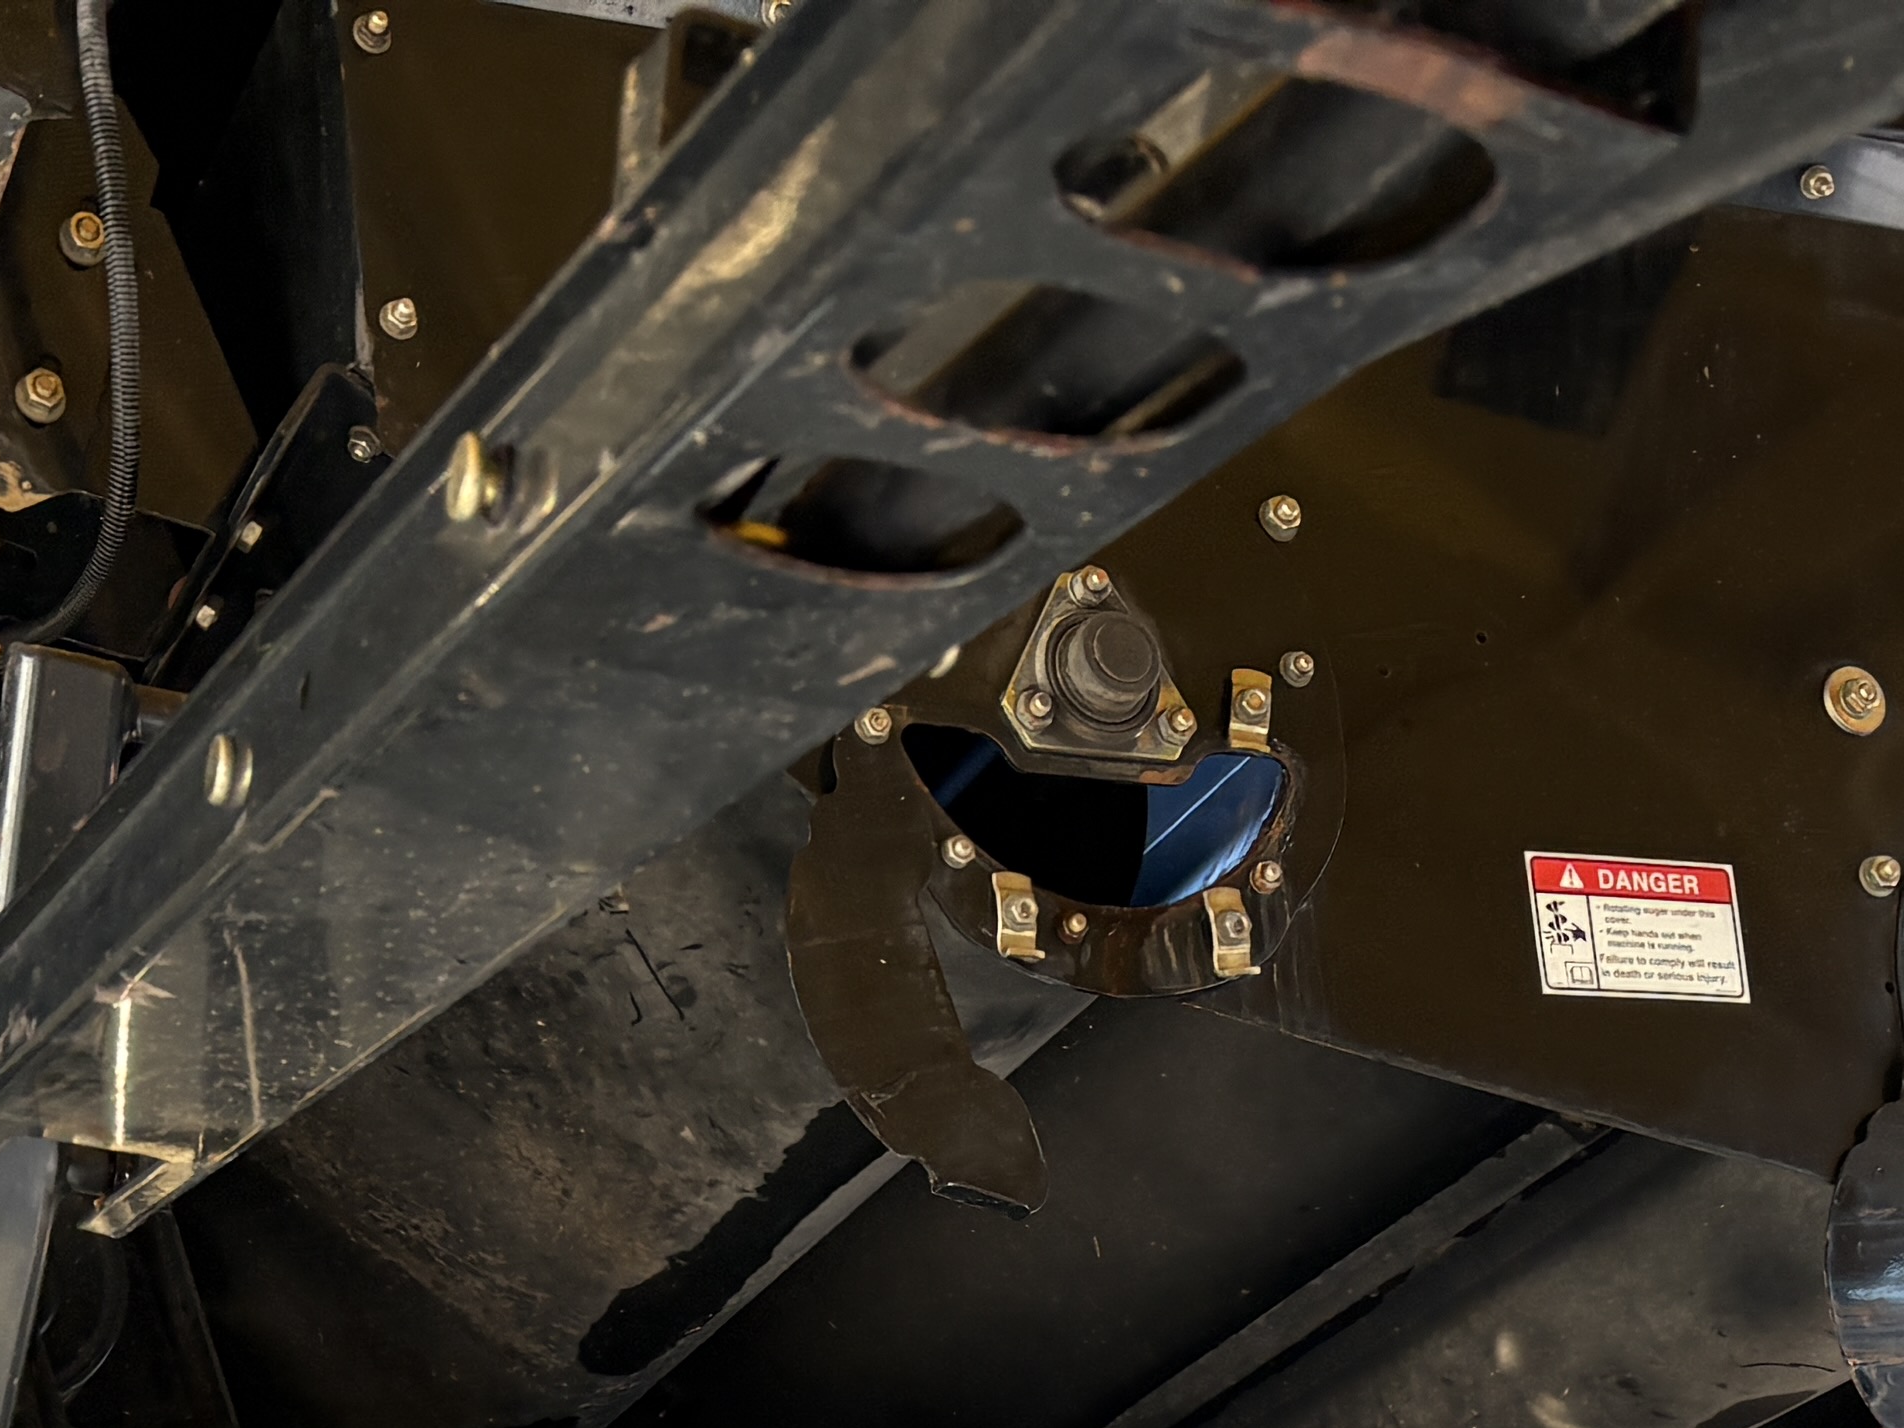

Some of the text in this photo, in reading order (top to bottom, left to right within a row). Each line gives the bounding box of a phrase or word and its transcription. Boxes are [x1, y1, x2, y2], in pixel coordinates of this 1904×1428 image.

[1597, 868, 1699, 895] DANGER
[1603, 903, 1641, 915] Rotating
[1606, 927, 1630, 938] Keep
[1631, 929, 1659, 938] hands
[1678, 932, 1702, 941] when
[1607, 940, 1645, 949] machine
[1599, 953, 1736, 970] Failure to comply will result
[1601, 967, 1611, 977] in
[1613, 969, 1642, 979] death
[1644, 971, 1655, 979] or
[1657, 971, 1694, 982] serious
